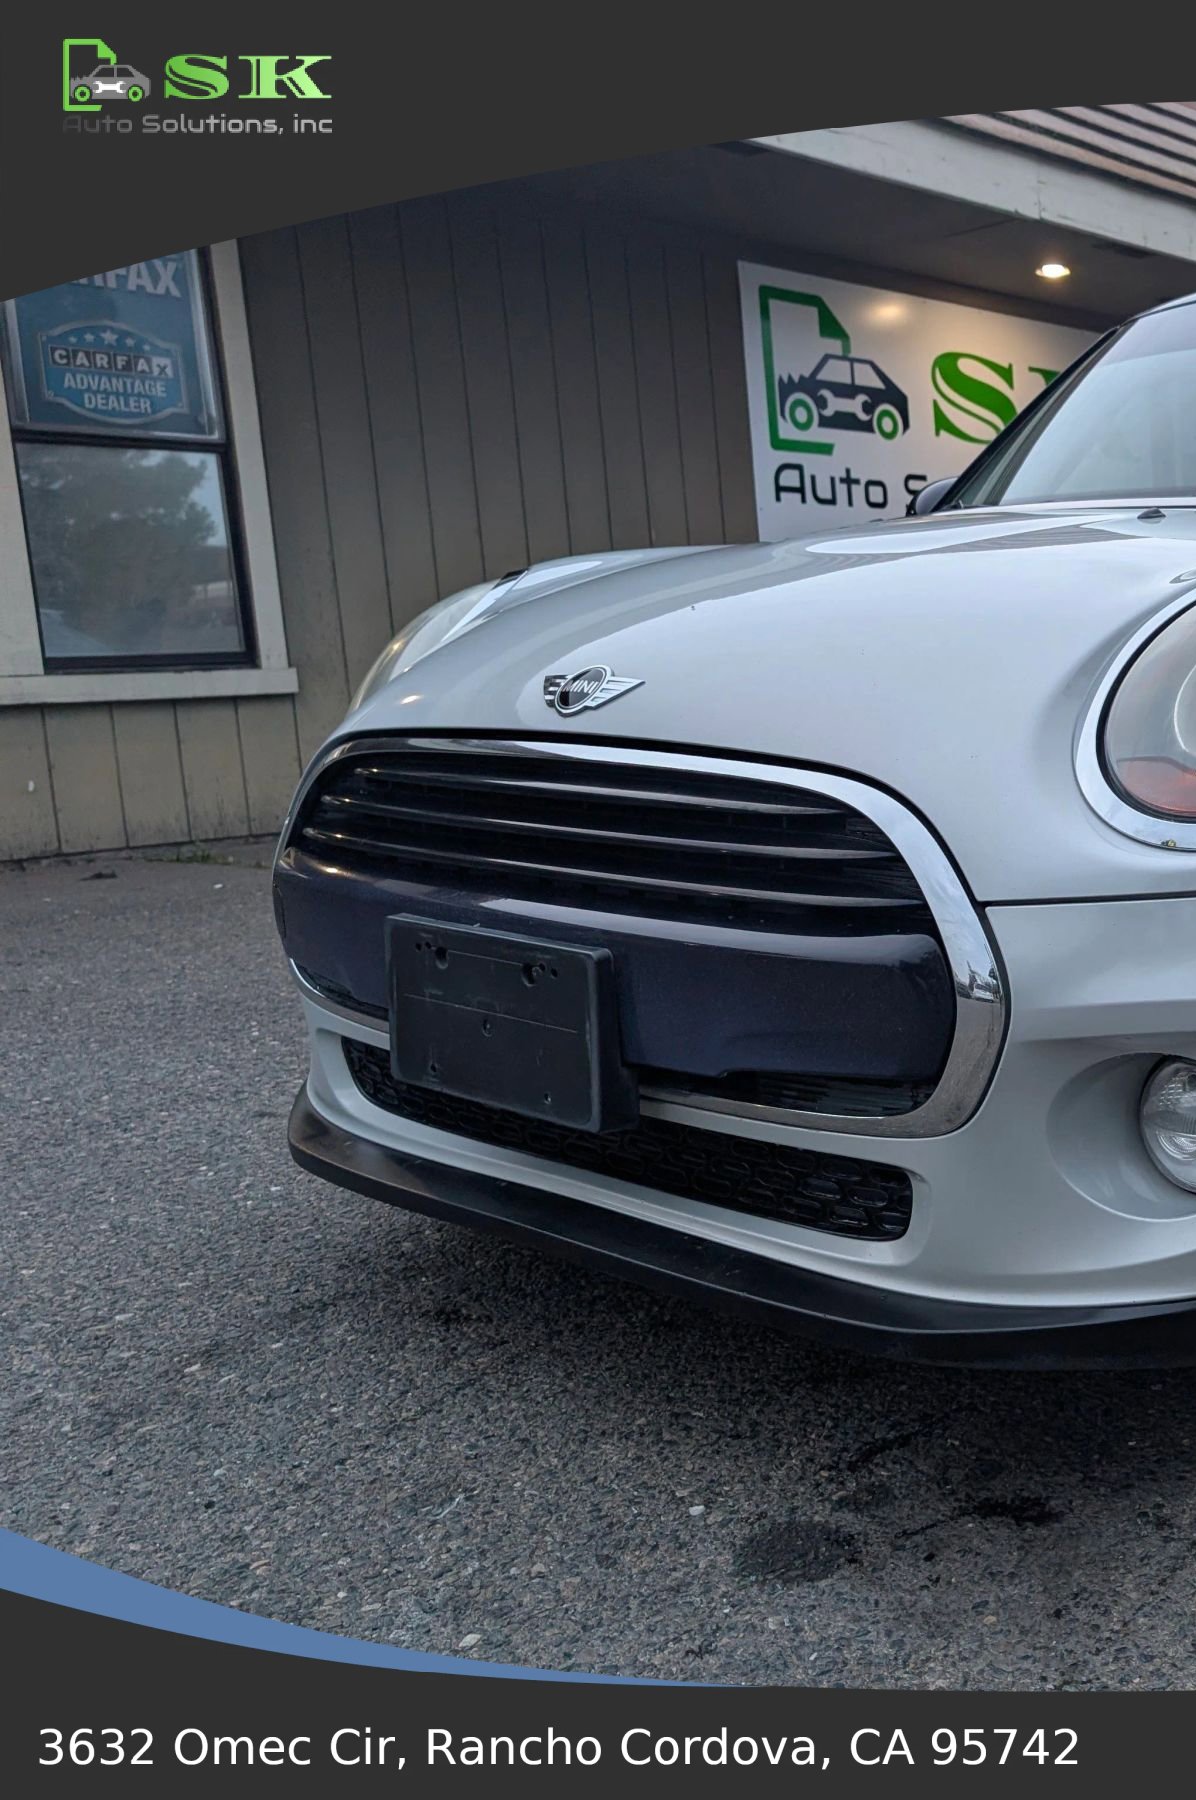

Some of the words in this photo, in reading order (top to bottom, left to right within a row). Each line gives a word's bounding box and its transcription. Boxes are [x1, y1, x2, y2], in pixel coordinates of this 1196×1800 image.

[52, 350, 172, 378] CARFAX
[63, 372, 167, 397] ADVANTAGE
[84, 393, 151, 414] DEALER
[774, 463, 888, 509] Auto
[563, 679, 599, 694] MINI
